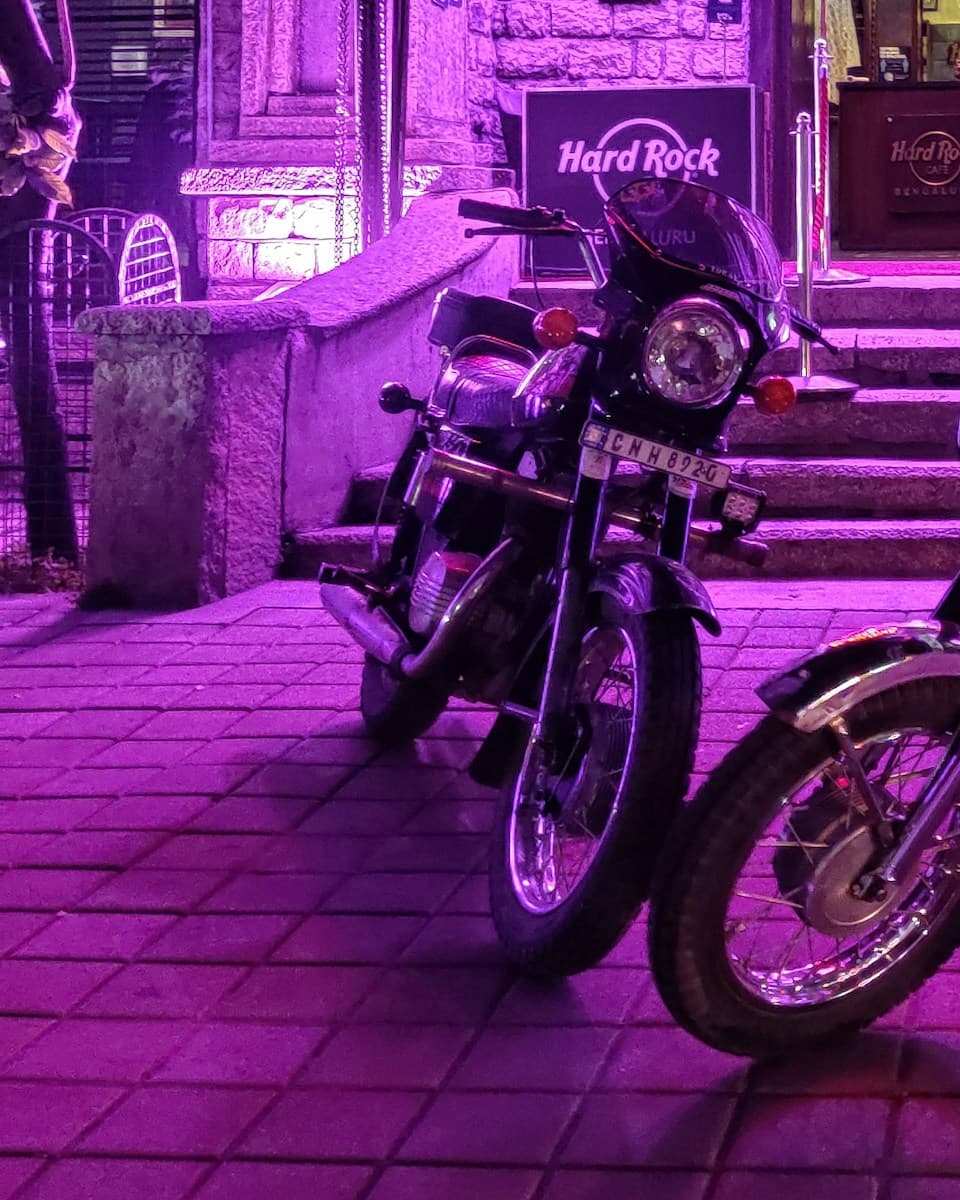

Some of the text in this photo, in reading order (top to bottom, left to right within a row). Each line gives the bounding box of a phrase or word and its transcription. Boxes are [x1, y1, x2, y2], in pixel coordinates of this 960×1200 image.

[557, 138, 720, 178] Hard Rock
[890, 140, 936, 161] Hard
